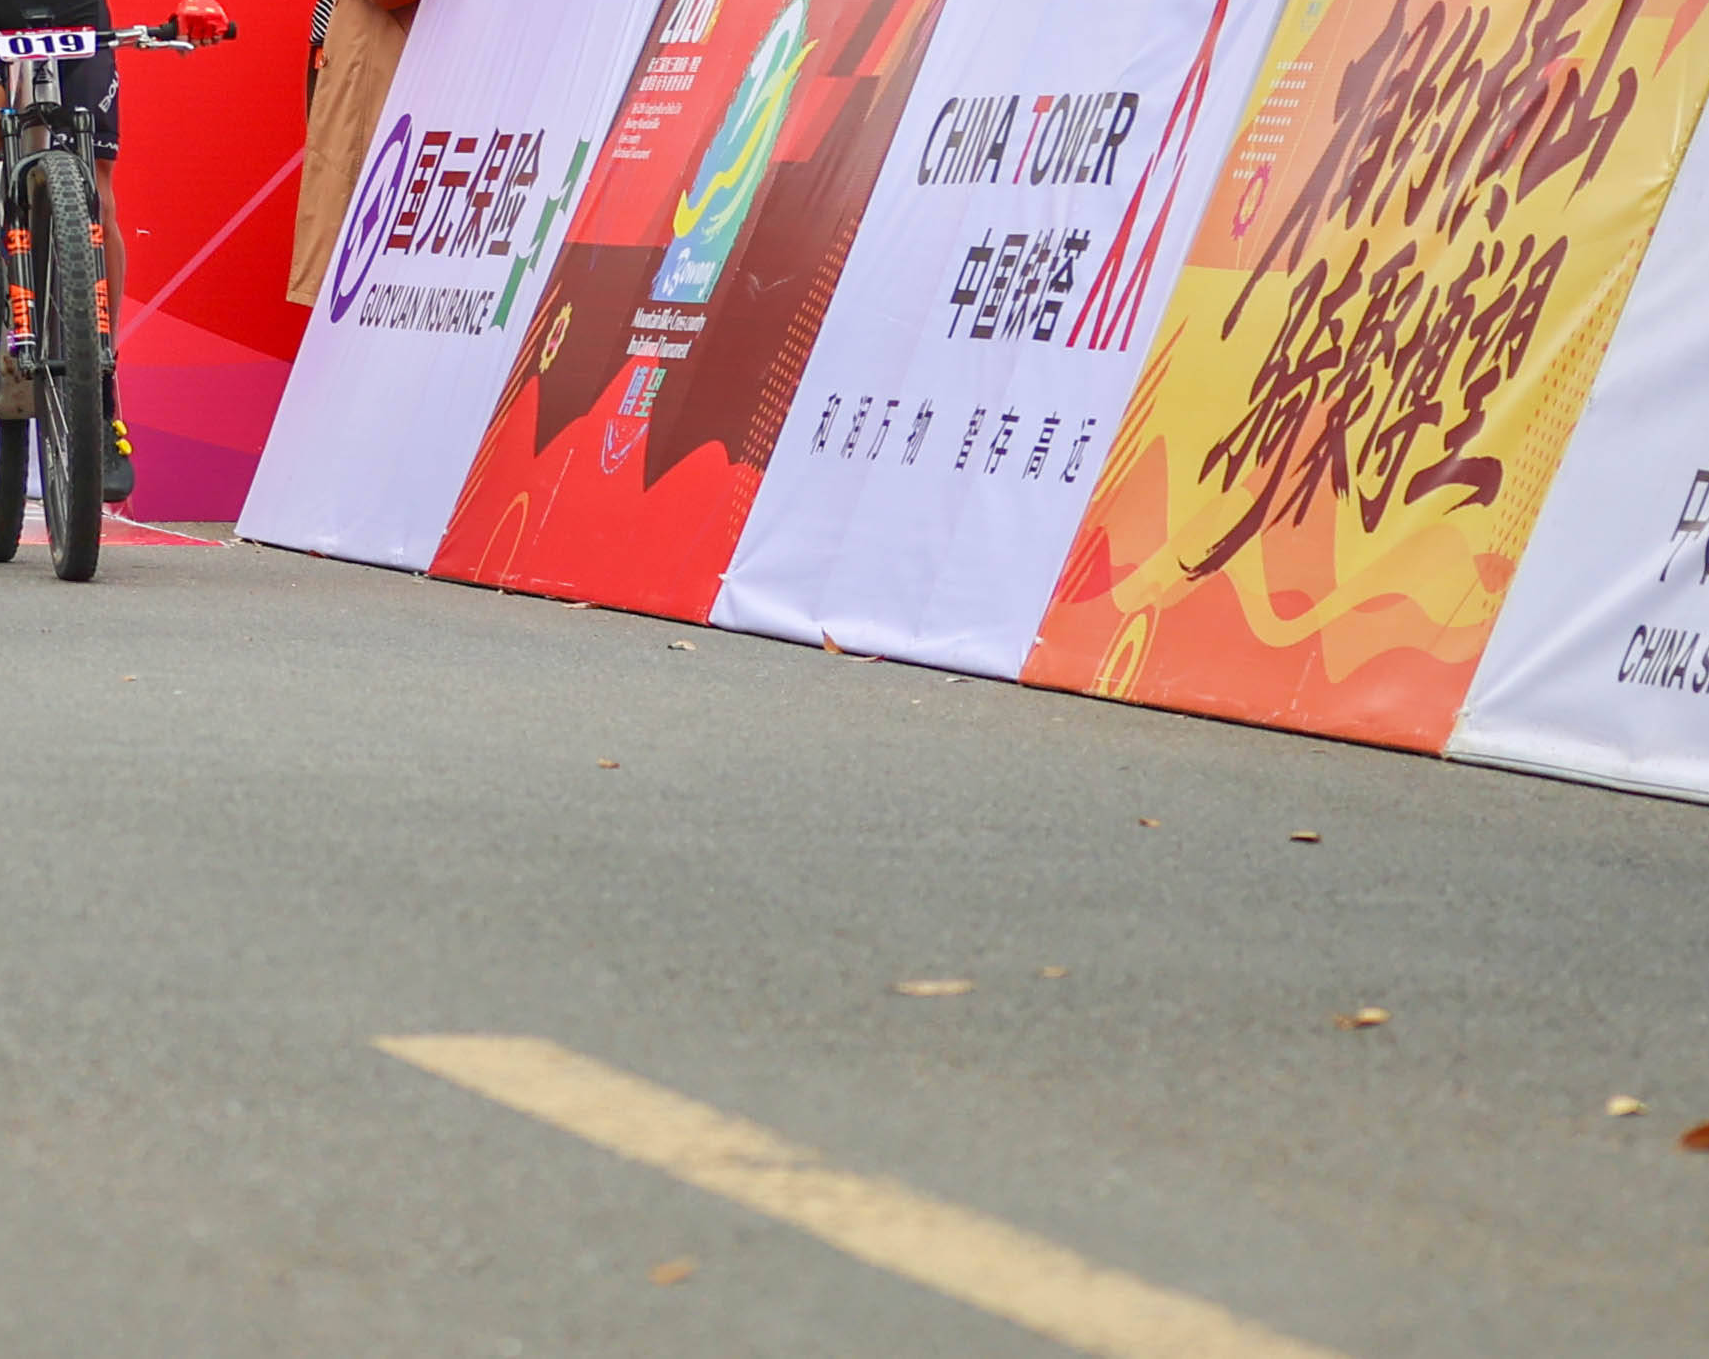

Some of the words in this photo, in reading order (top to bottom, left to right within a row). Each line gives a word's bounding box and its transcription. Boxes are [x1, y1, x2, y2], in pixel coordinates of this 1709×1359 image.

[8, 33, 86, 56] 019
[917, 94, 1021, 187] CHINA
[1011, 90, 1141, 187] TOWER
[383, 127, 546, 260] 国元保险
[358, 283, 418, 330] GUOYUAN
[418, 287, 493, 336] INSURANCE
[948, 227, 1091, 342] 中国铁塔
[810, 391, 935, 465] 和润万物
[955, 407, 1098, 485] 智存高远
[1179, 233, 1568, 582] 骑聚博望
[1618, 624, 1699, 688] CHINA
